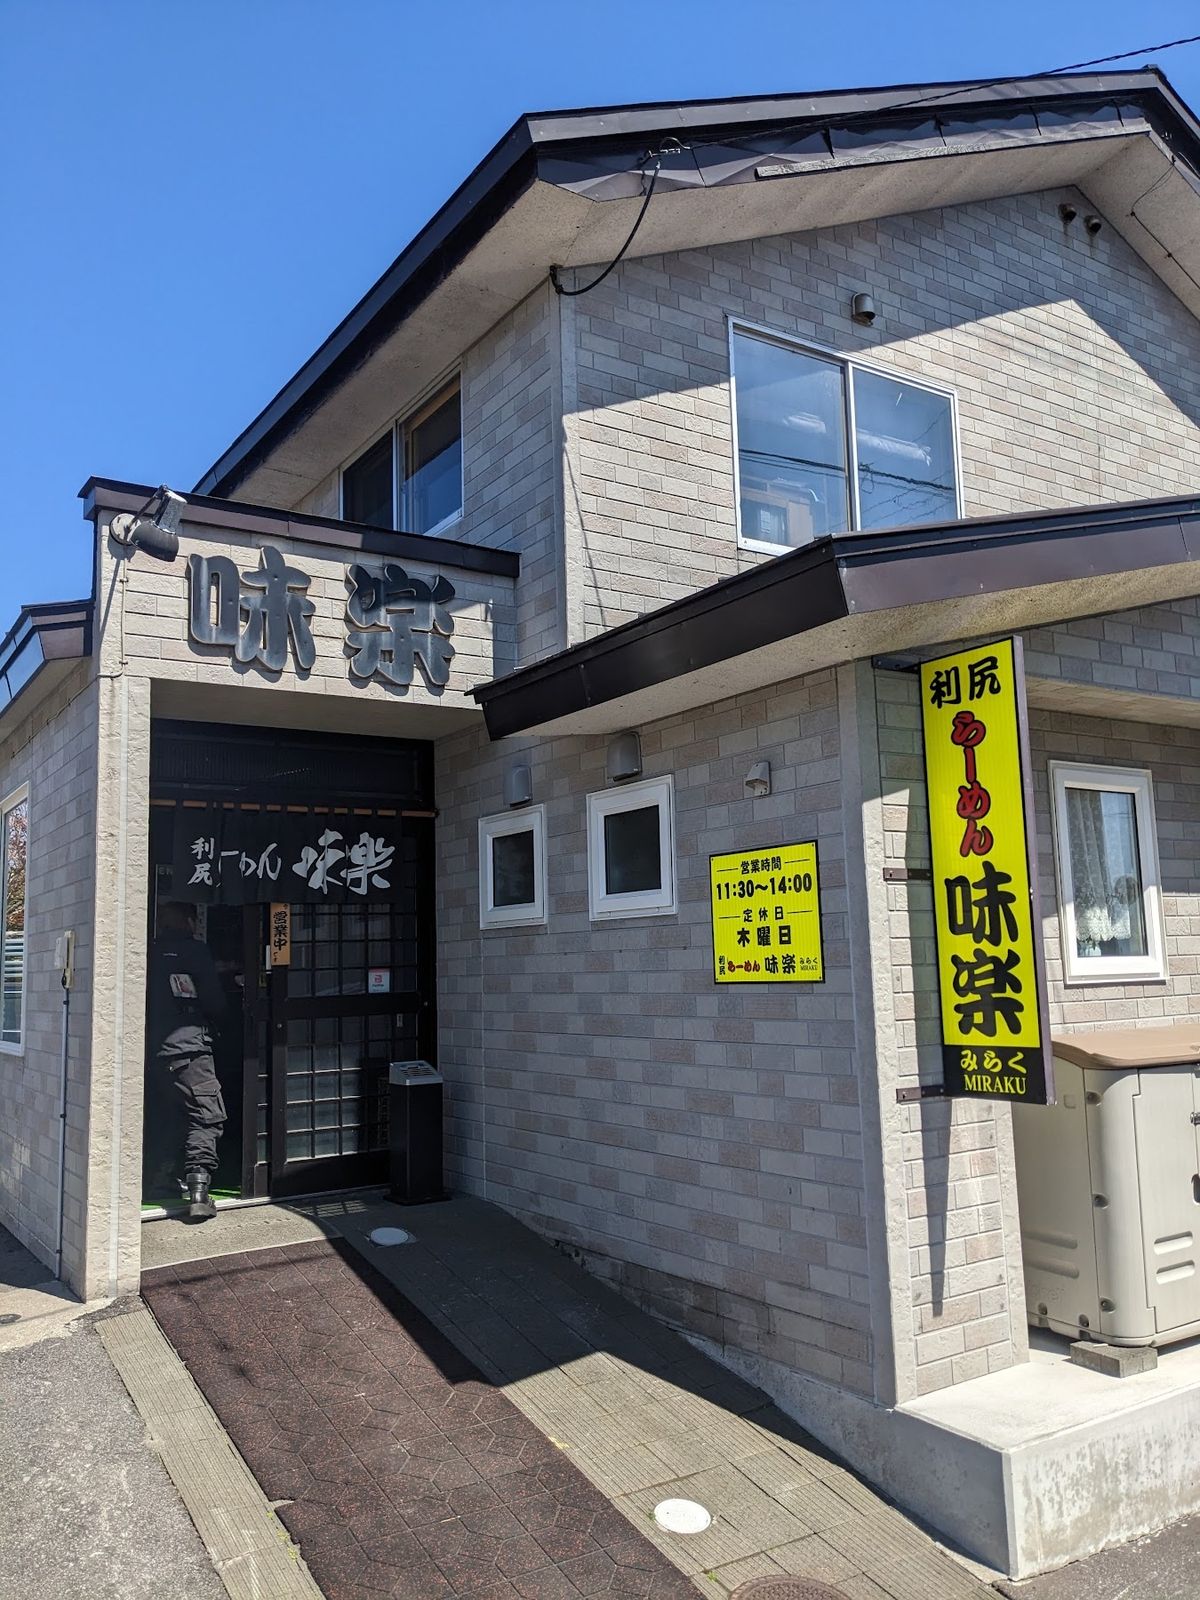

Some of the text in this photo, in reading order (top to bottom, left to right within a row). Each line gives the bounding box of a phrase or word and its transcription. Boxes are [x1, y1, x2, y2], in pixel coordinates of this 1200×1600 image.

[187, 545, 456, 687] 味楽
[929, 655, 1001, 710] 利尻
[950, 710, 995, 858] らーめん
[187, 836, 215, 887] 利尻
[740, 856, 782, 875] 営業時間
[743, 906, 784, 923] 定休日
[737, 925, 792, 947] 木曜日
[944, 860, 1024, 1037] 味楽
[764, 954, 796, 975] 味楽
[960, 1048, 1028, 1073] みらく
[964, 1073, 1027, 1096] MIRAKU
